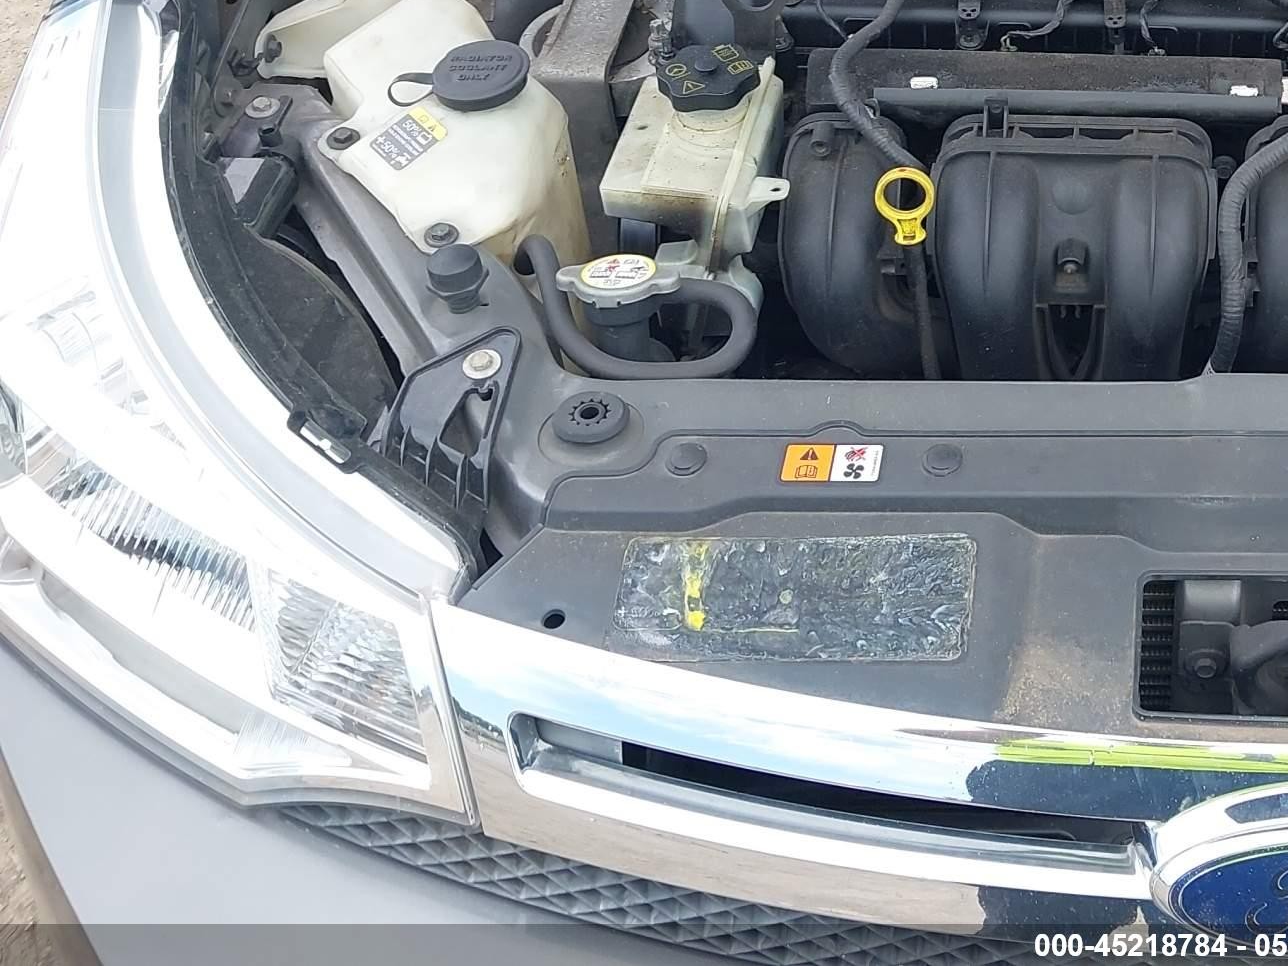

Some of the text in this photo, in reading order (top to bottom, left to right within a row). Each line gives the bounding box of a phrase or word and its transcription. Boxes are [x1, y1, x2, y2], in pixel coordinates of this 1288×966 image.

[449, 64, 508, 72] COOLANT
[456, 73, 491, 81] ONLY
[402, 119, 422, 137] 50%
